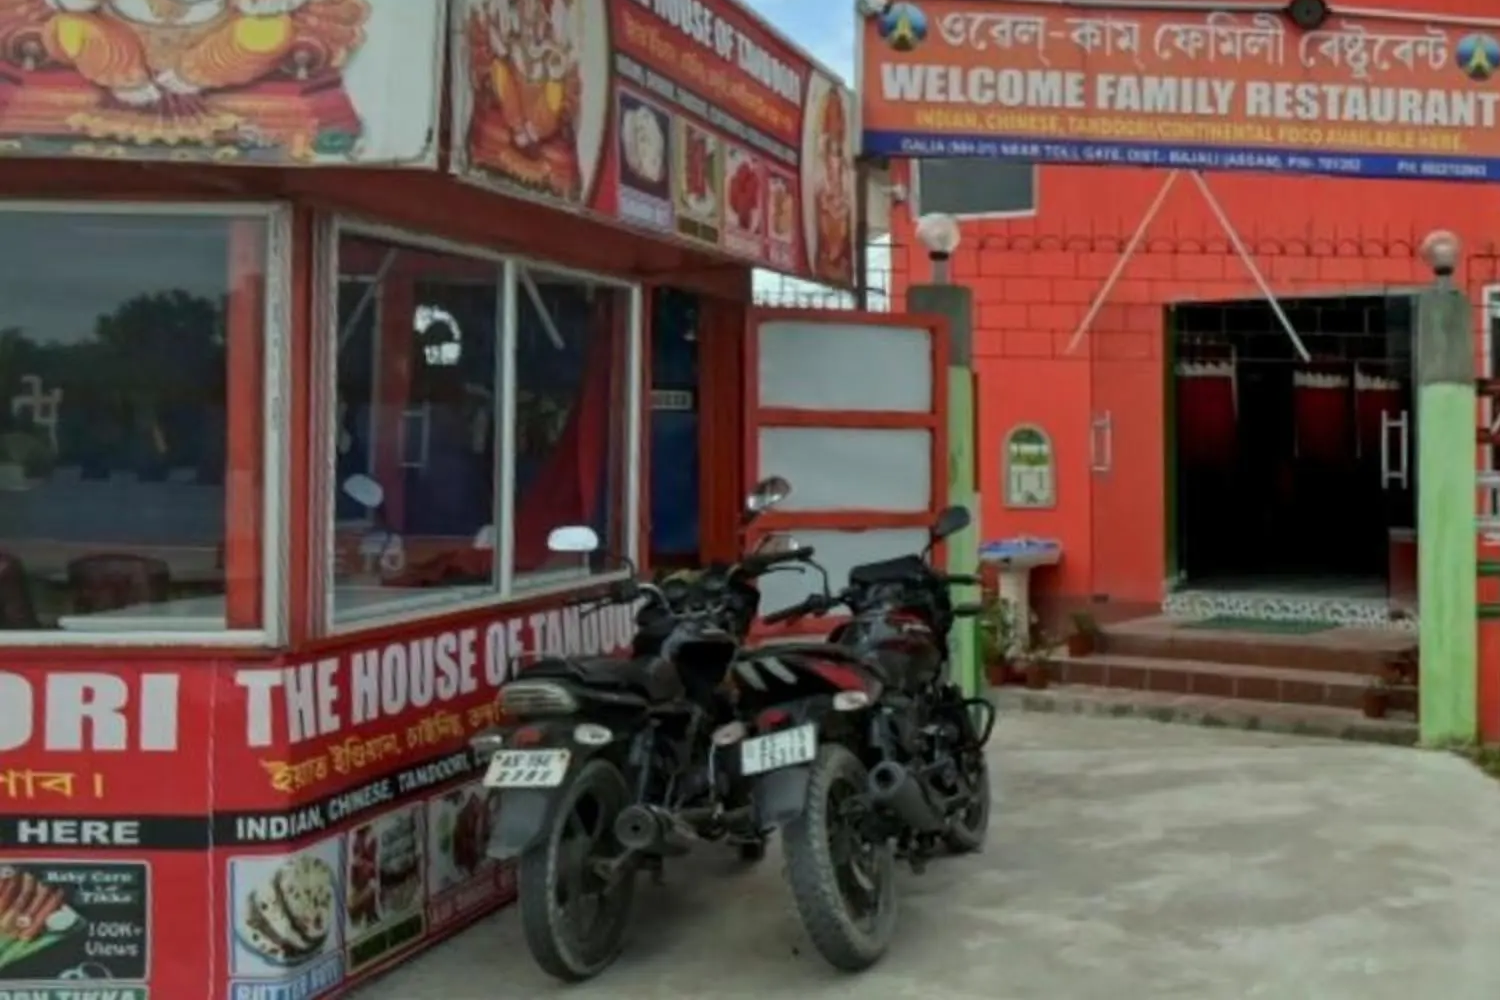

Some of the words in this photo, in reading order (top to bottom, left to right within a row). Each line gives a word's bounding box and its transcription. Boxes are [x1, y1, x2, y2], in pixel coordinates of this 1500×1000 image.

[714, 17, 735, 62] OF
[880, 62, 1086, 107] WELCOME
[1096, 73, 1236, 115] FAMILY
[234, 657, 342, 748] THE
[351, 627, 478, 727] HOUSE
[485, 617, 524, 687] OF
[17, 819, 141, 845] HERE
[235, 806, 326, 840] INDIAN,
